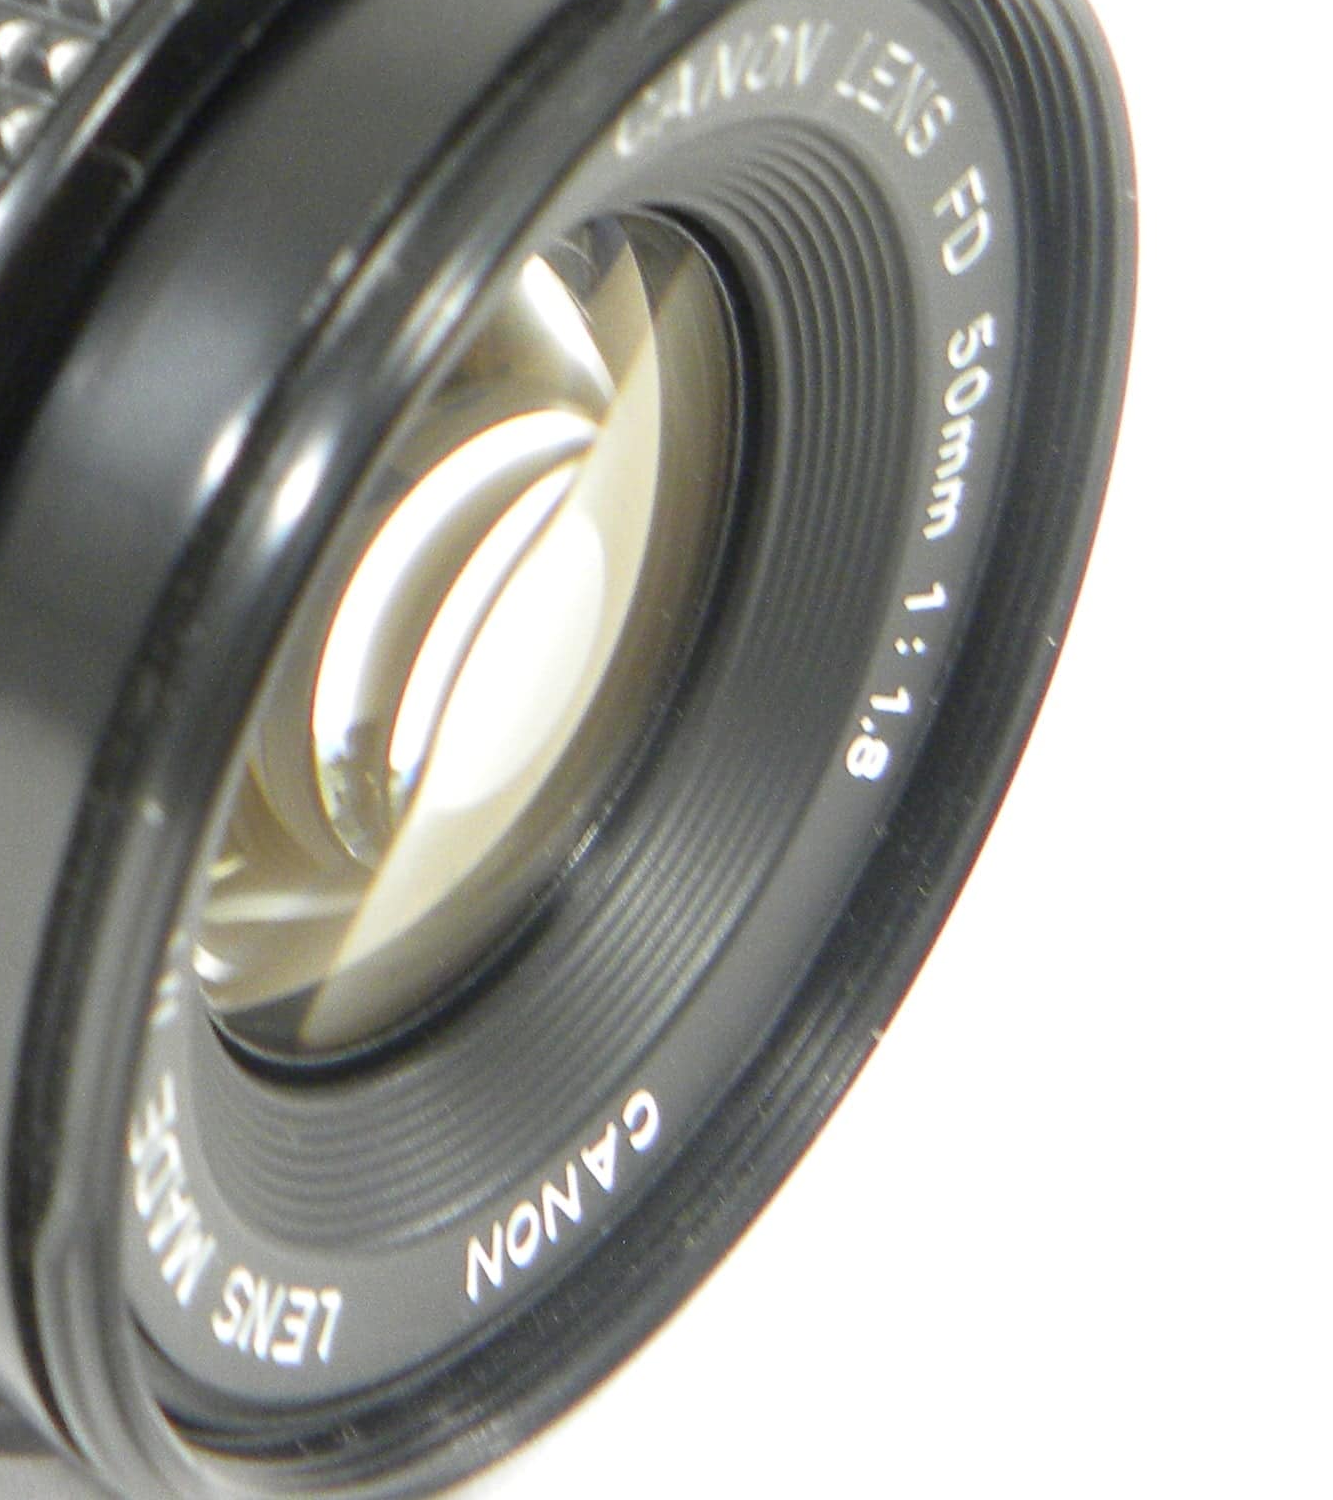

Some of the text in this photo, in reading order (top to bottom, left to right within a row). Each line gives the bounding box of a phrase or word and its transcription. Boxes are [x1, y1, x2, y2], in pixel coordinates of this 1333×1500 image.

[615, 18, 831, 156] CANON
[835, 29, 961, 157] LENS
[932, 164, 993, 276] FD
[922, 312, 998, 542] 50mm
[465, 1088, 661, 1302] CANON
[212, 1264, 343, 1366] LENS
